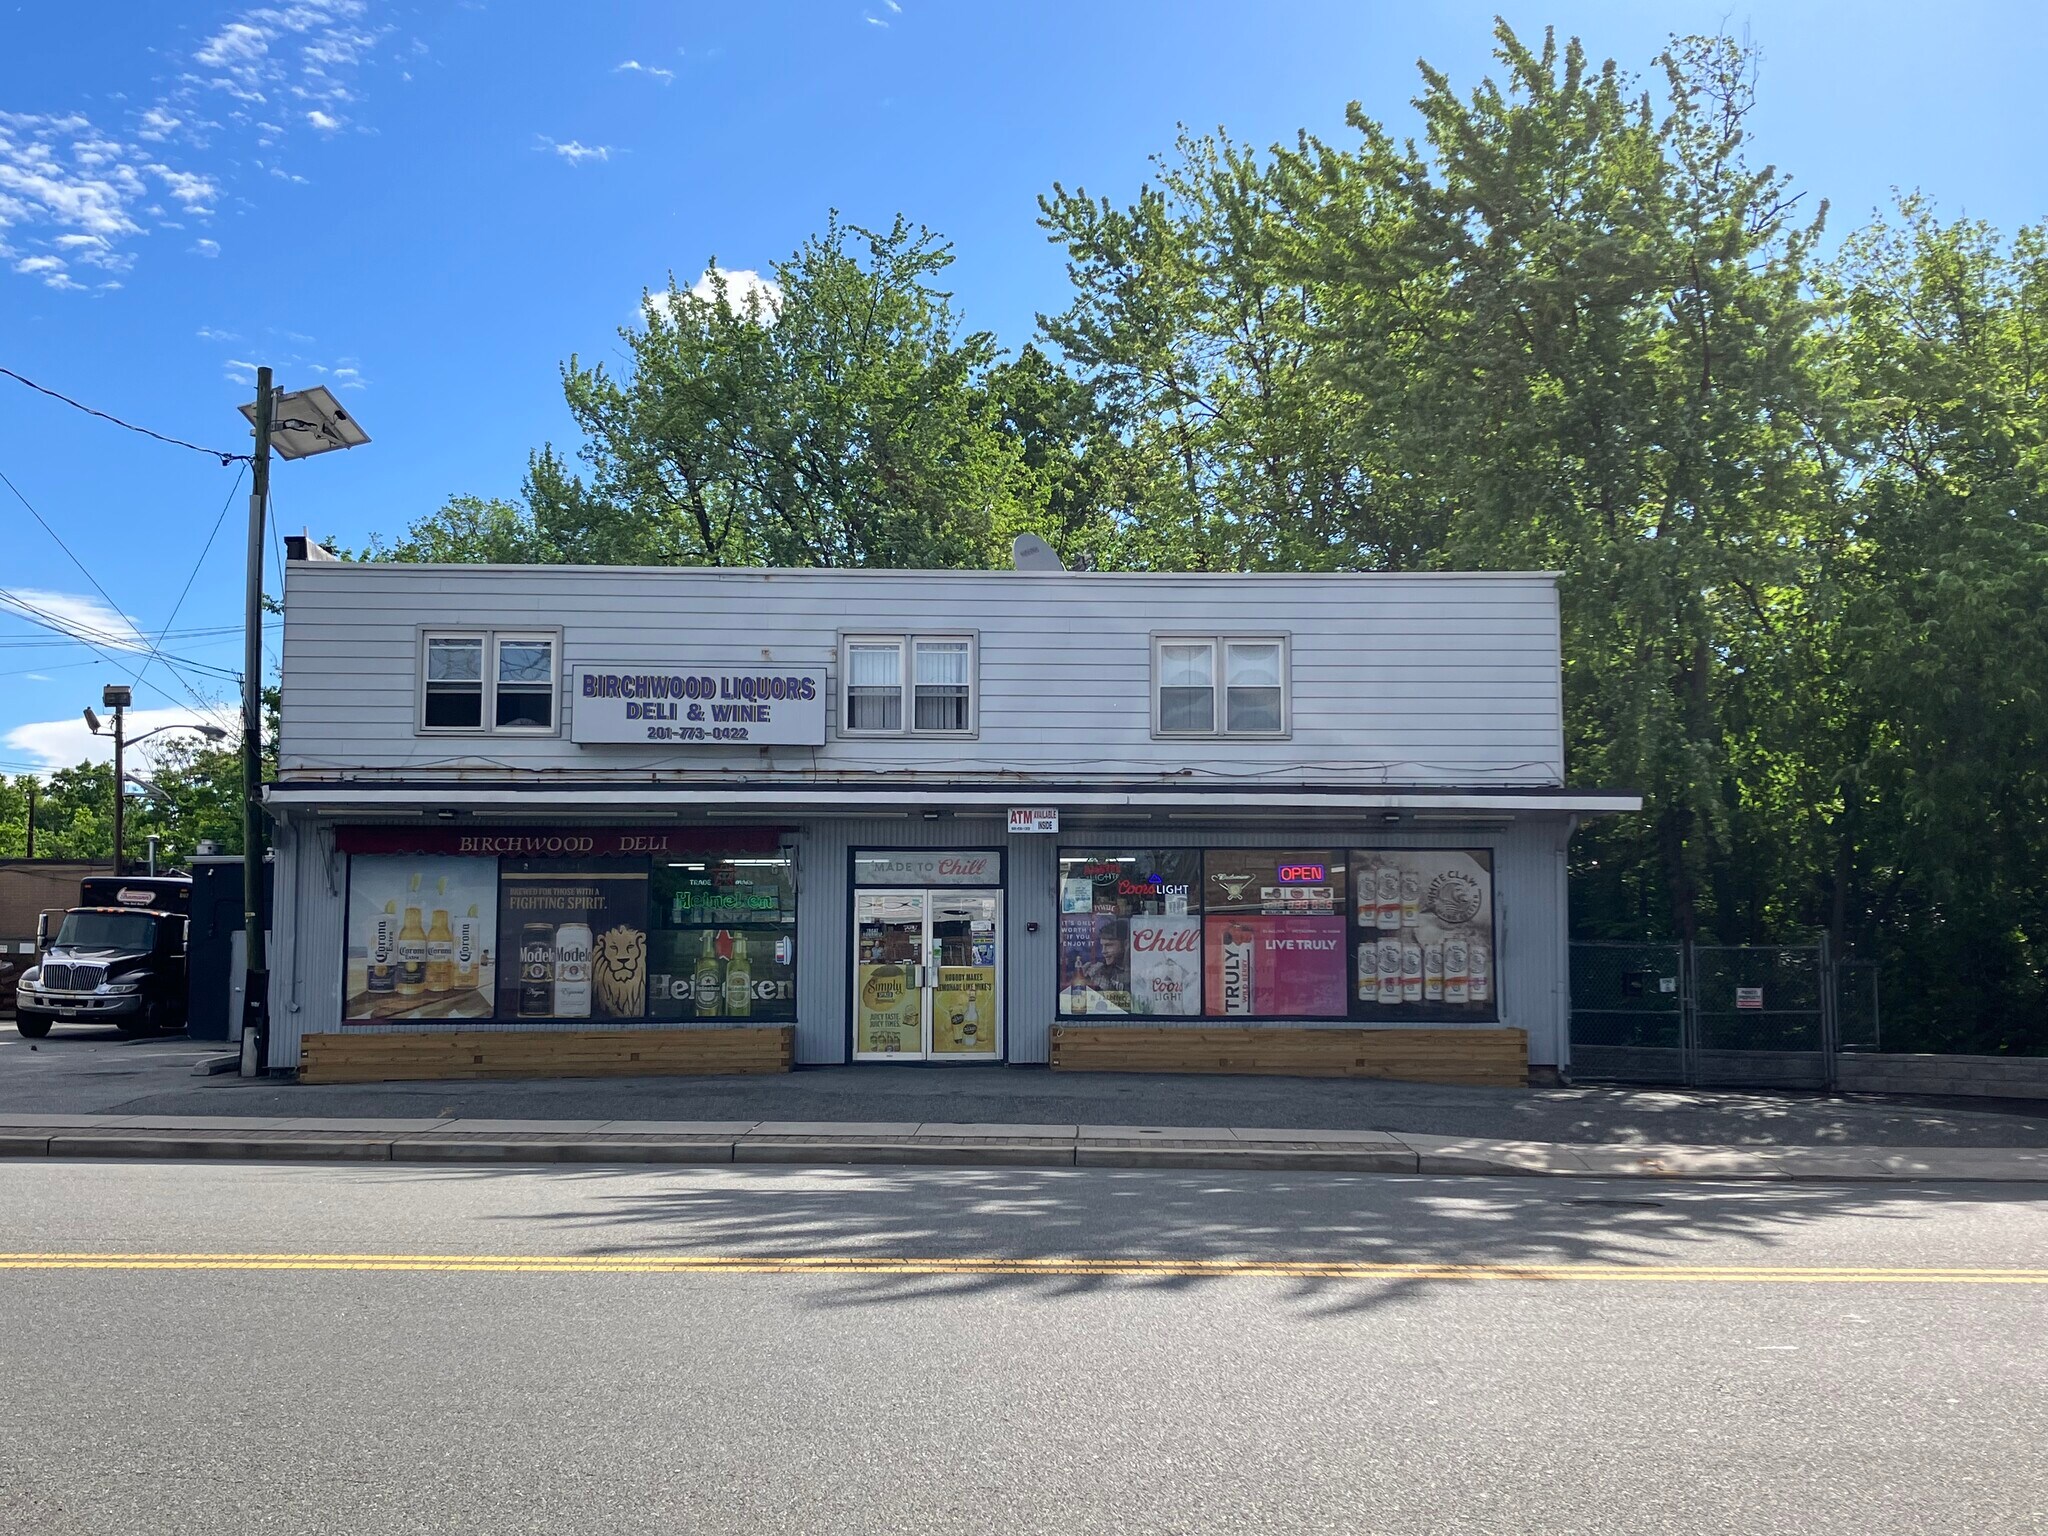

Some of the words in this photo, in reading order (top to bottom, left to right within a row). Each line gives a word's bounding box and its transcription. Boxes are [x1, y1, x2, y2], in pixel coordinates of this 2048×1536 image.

[582, 674, 718, 700] BIRCHWOOD
[720, 676, 816, 702] LIQUORS
[626, 702, 678, 721] DELI
[686, 703, 705, 722] &
[711, 705, 771, 722] WINE
[647, 726, 749, 741] 201-773-0422
[1010, 810, 1033, 825] ATM
[1033, 810, 1057, 819] AVAILABLE
[1037, 821, 1053, 830] INSIDE
[459, 836, 594, 852] BIRCHWOOD
[619, 836, 669, 850] DELI
[873, 862, 912, 872] MADE
[918, 862, 934, 872] TO
[938, 858, 988, 876] Chill
[1281, 866, 1322, 881] OPEN
[510, 887, 538, 896] BREWED
[553, 887, 576, 896] THOSE
[576, 887, 594, 896] WITH
[594, 888, 600, 896] A
[1118, 880, 1156, 895] Coors
[1156, 884, 1189, 895] LIGHT
[1428, 873, 1447, 905] WHITE
[1447, 870, 1478, 888] CLAW
[510, 896, 565, 910] FIGHTING
[567, 896, 608, 910] SPIRIT.
[374, 921, 389, 963] Corona
[459, 923, 473, 963] Corona
[1133, 929, 1200, 952] Chill
[1265, 939, 1295, 950] LIVE
[1297, 939, 1337, 950] TRULY
[399, 947, 425, 956] Corona
[427, 947, 452, 956] Corona
[944, 973, 965, 982] NOBODY
[965, 973, 983, 981] MAKES
[1225, 949, 1240, 1012] TRULY
[867, 979, 904, 995] Simply
[962, 983, 975, 991] LIKE
[1155, 993, 1182, 1001] LIGHT
